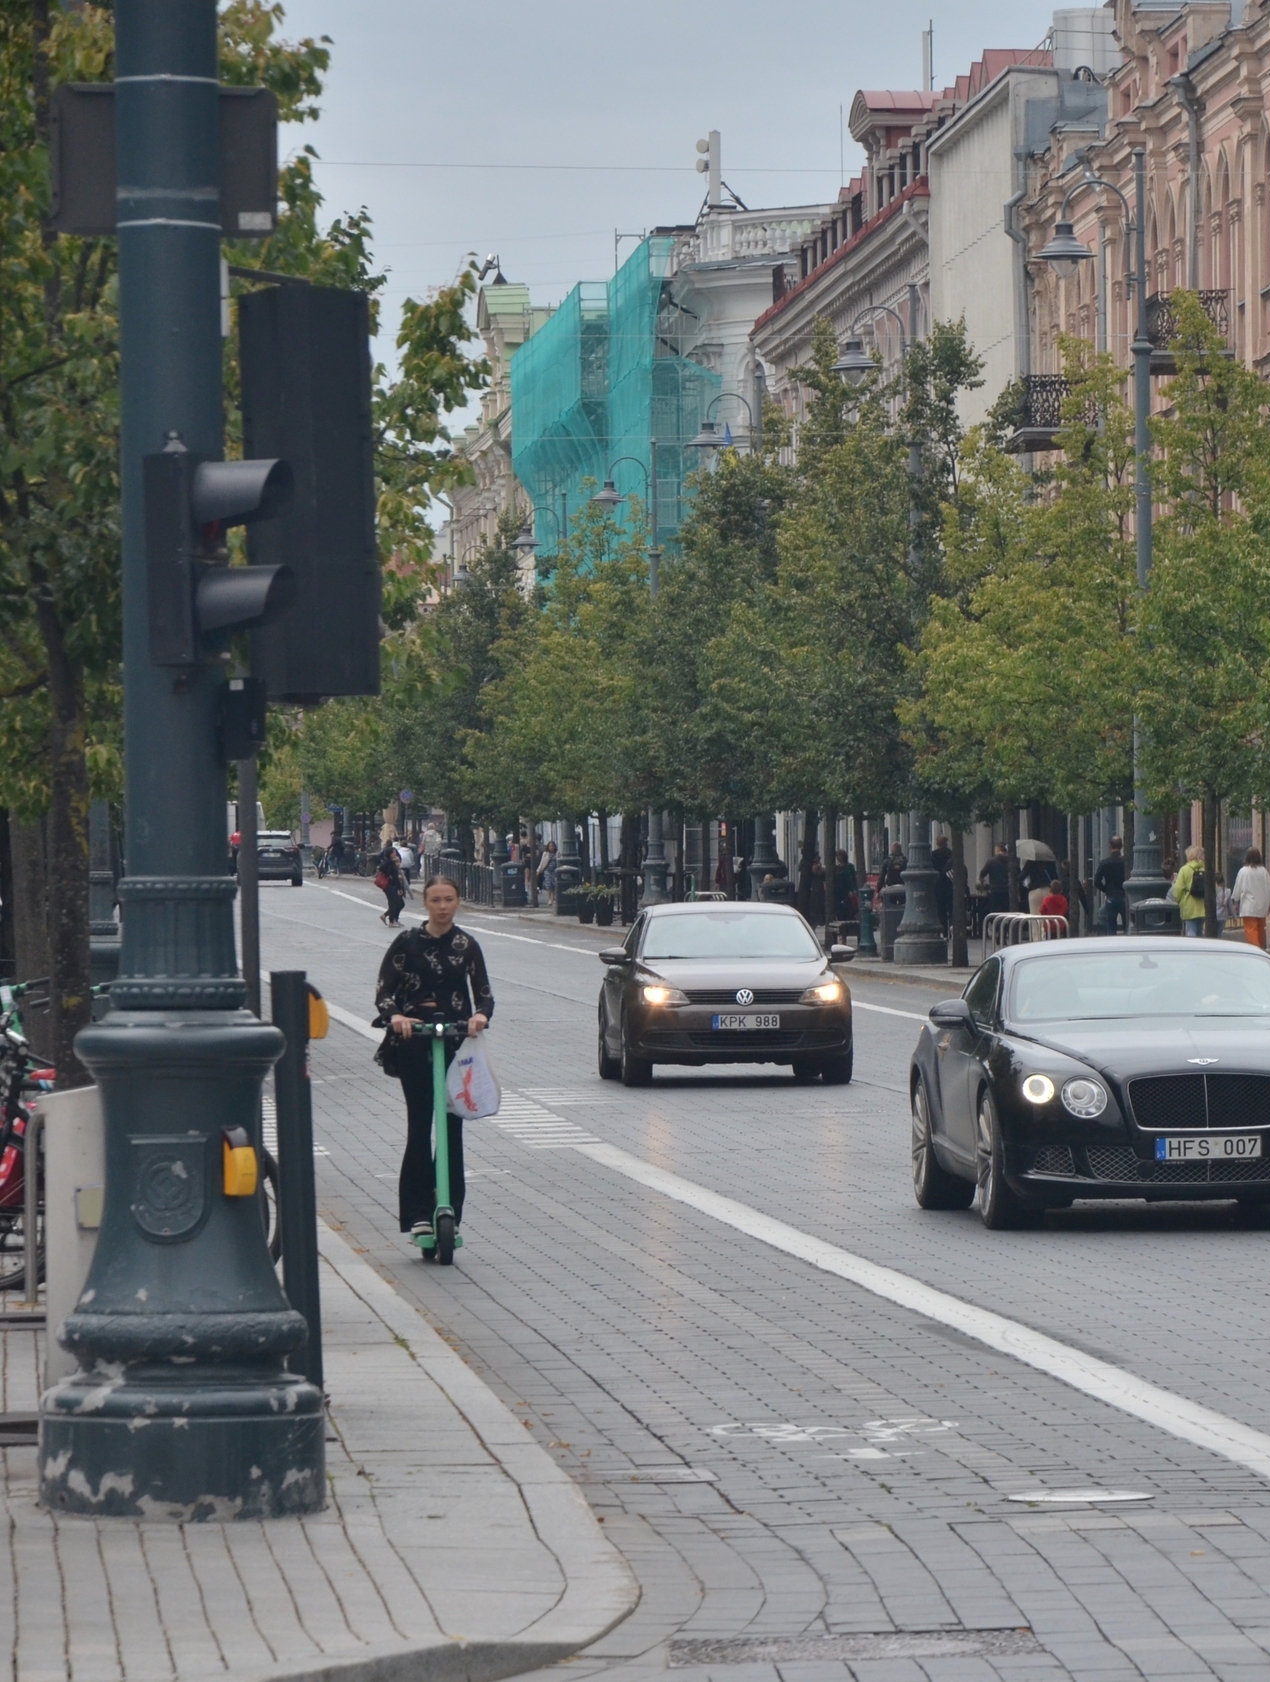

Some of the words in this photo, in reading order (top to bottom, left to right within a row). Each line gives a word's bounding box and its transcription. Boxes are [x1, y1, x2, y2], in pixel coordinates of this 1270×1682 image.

[720, 1016, 746, 1027] KPK
[755, 1016, 778, 1027] 988
[1168, 1139, 1210, 1157] HFS
[1223, 1138, 1258, 1156] 007
